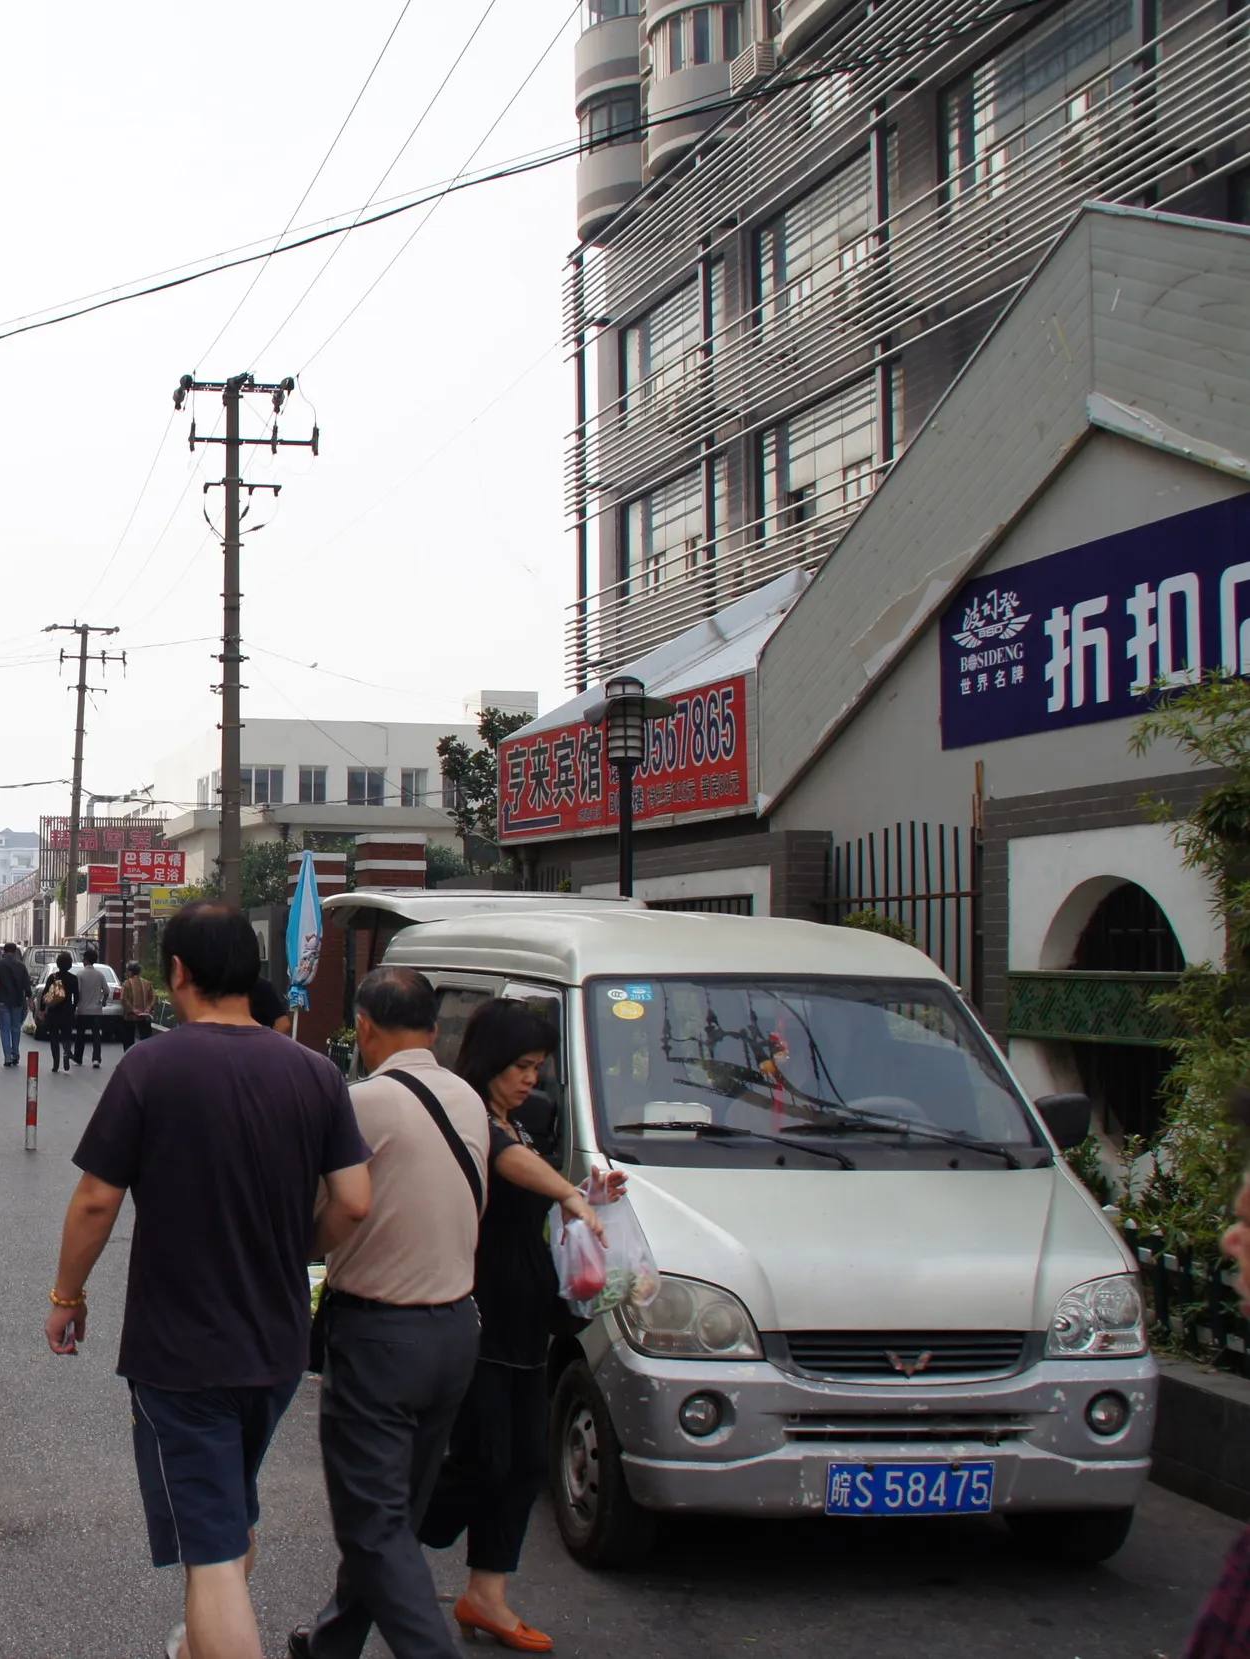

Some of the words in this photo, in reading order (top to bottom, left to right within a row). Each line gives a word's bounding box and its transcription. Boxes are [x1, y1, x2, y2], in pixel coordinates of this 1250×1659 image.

[962, 589, 1020, 632] 波司登
[960, 642, 1024, 673] BOSIDENG
[960, 665, 1024, 695] 世界名牌
[506, 727, 602, 814] 亨来宾馆
[125, 852, 181, 867] 巴蜀风情
[154, 868, 179, 881] 足浴
[885, 1470, 989, 1507] 58475
